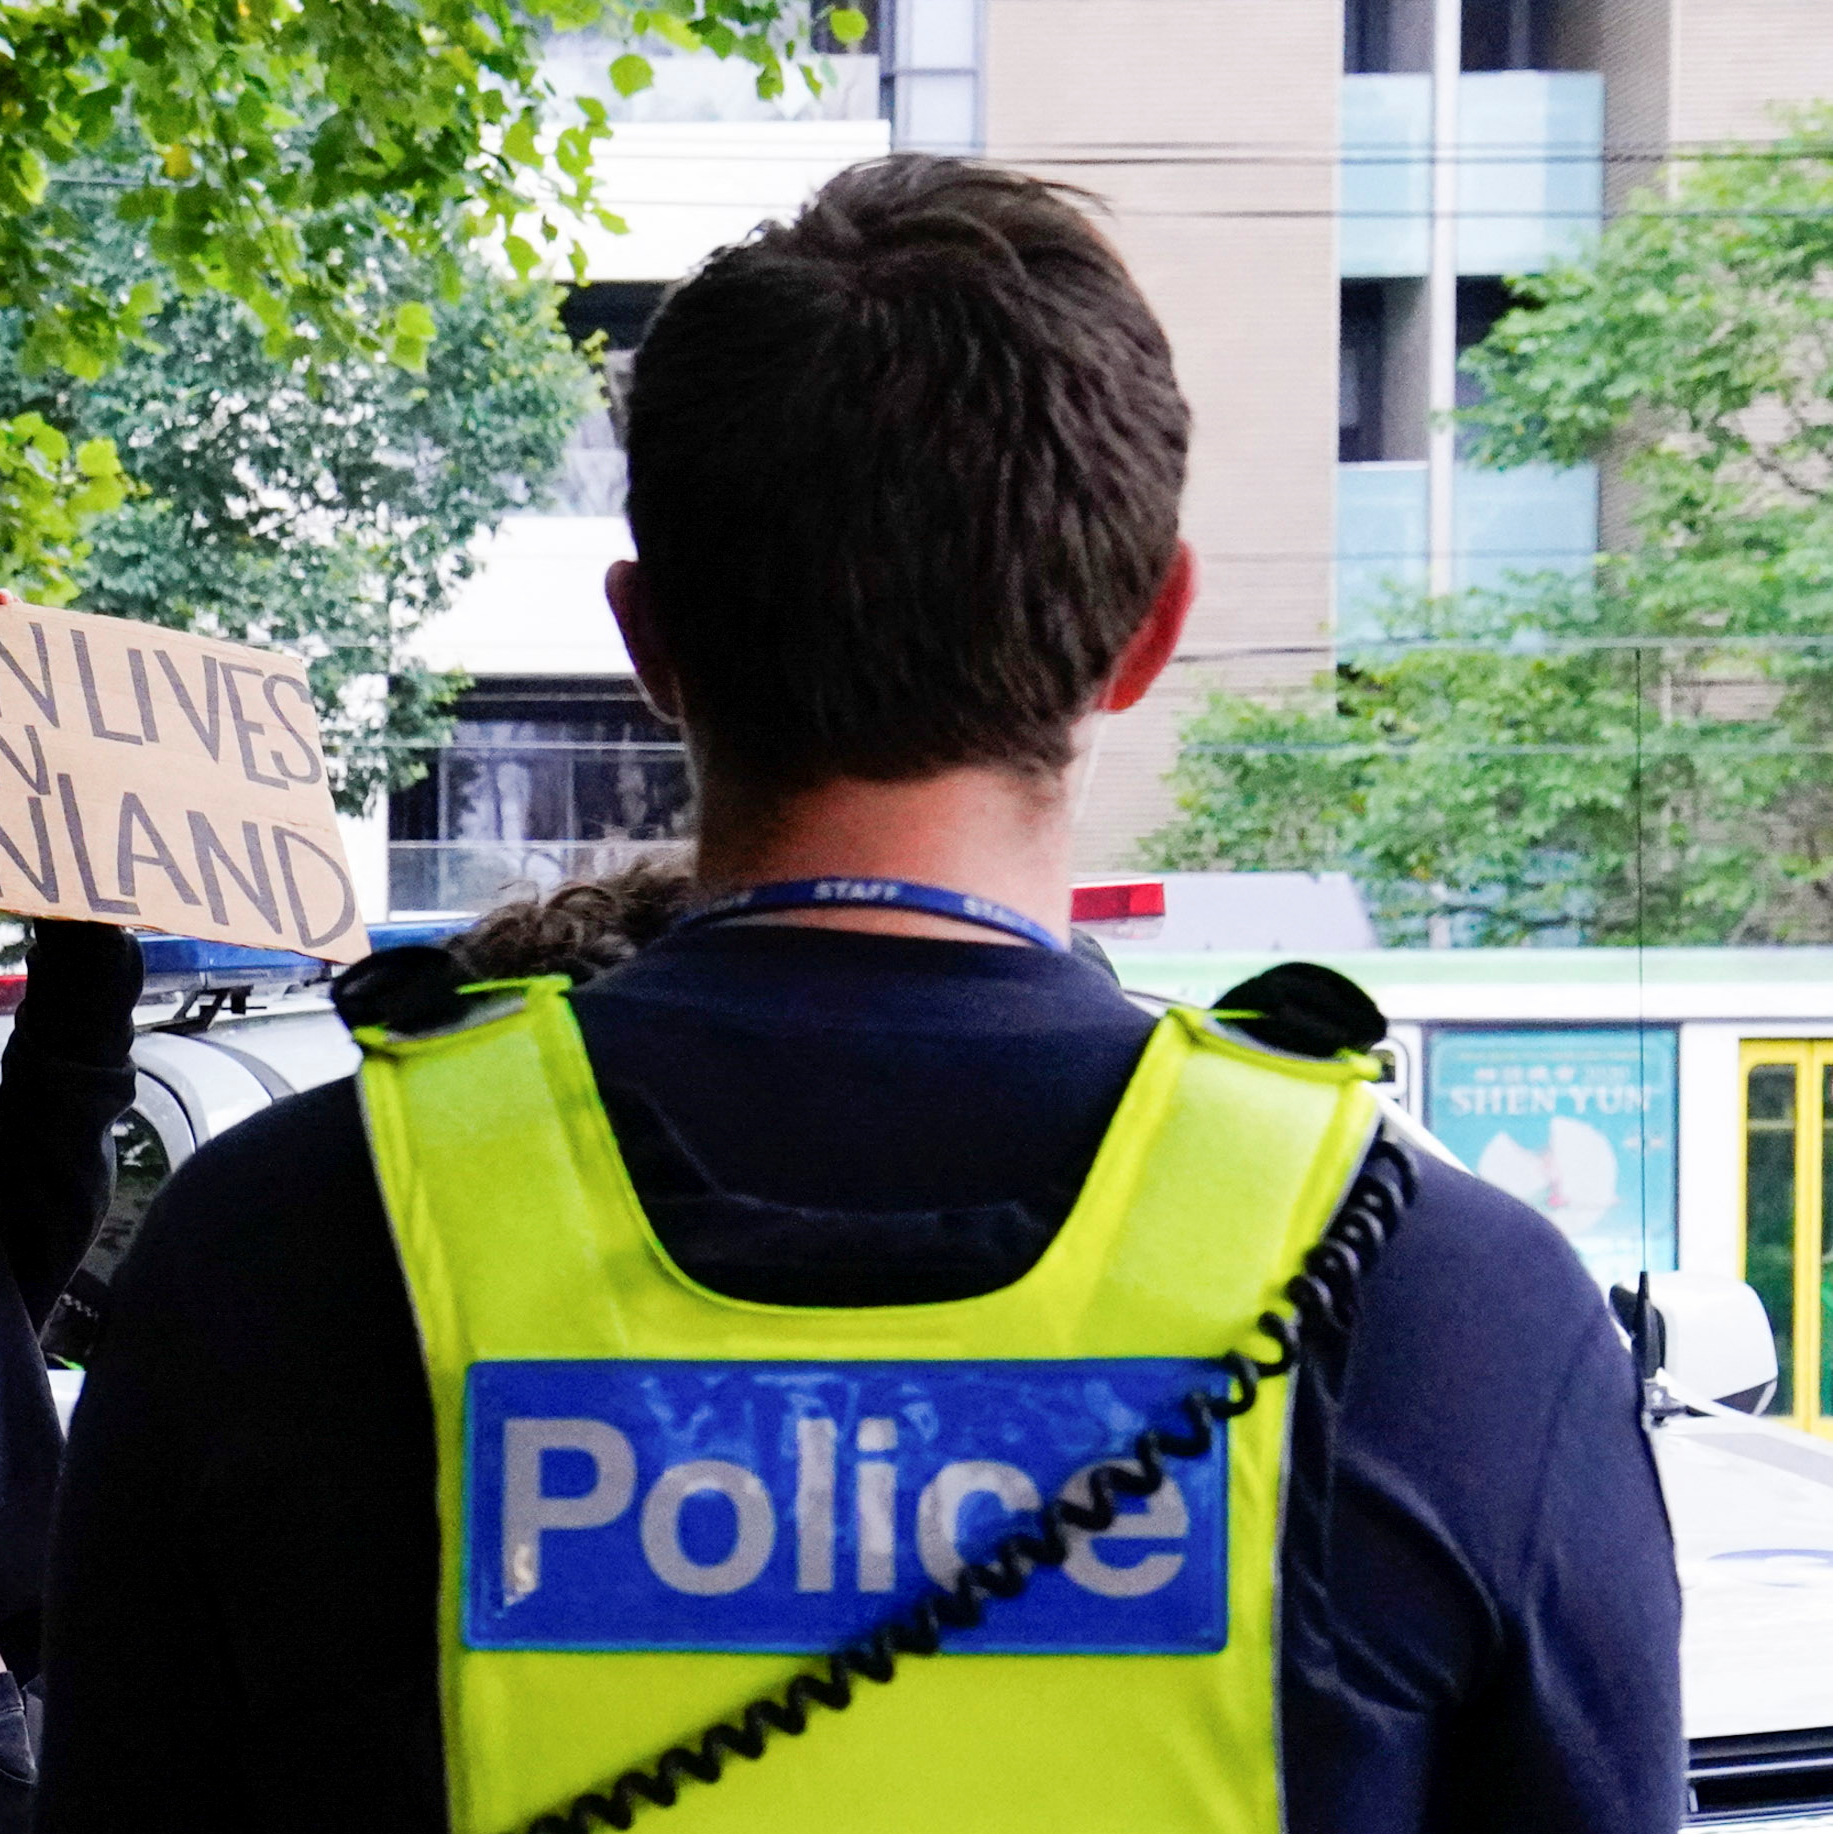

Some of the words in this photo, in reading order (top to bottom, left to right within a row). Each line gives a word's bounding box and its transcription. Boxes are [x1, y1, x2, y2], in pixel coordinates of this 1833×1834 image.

[69, 630, 322, 790] LIVES
[57, 772, 357, 949] LAND
[1449, 1086, 1557, 1115] SHEN
[502, 1417, 1190, 1603] Police
